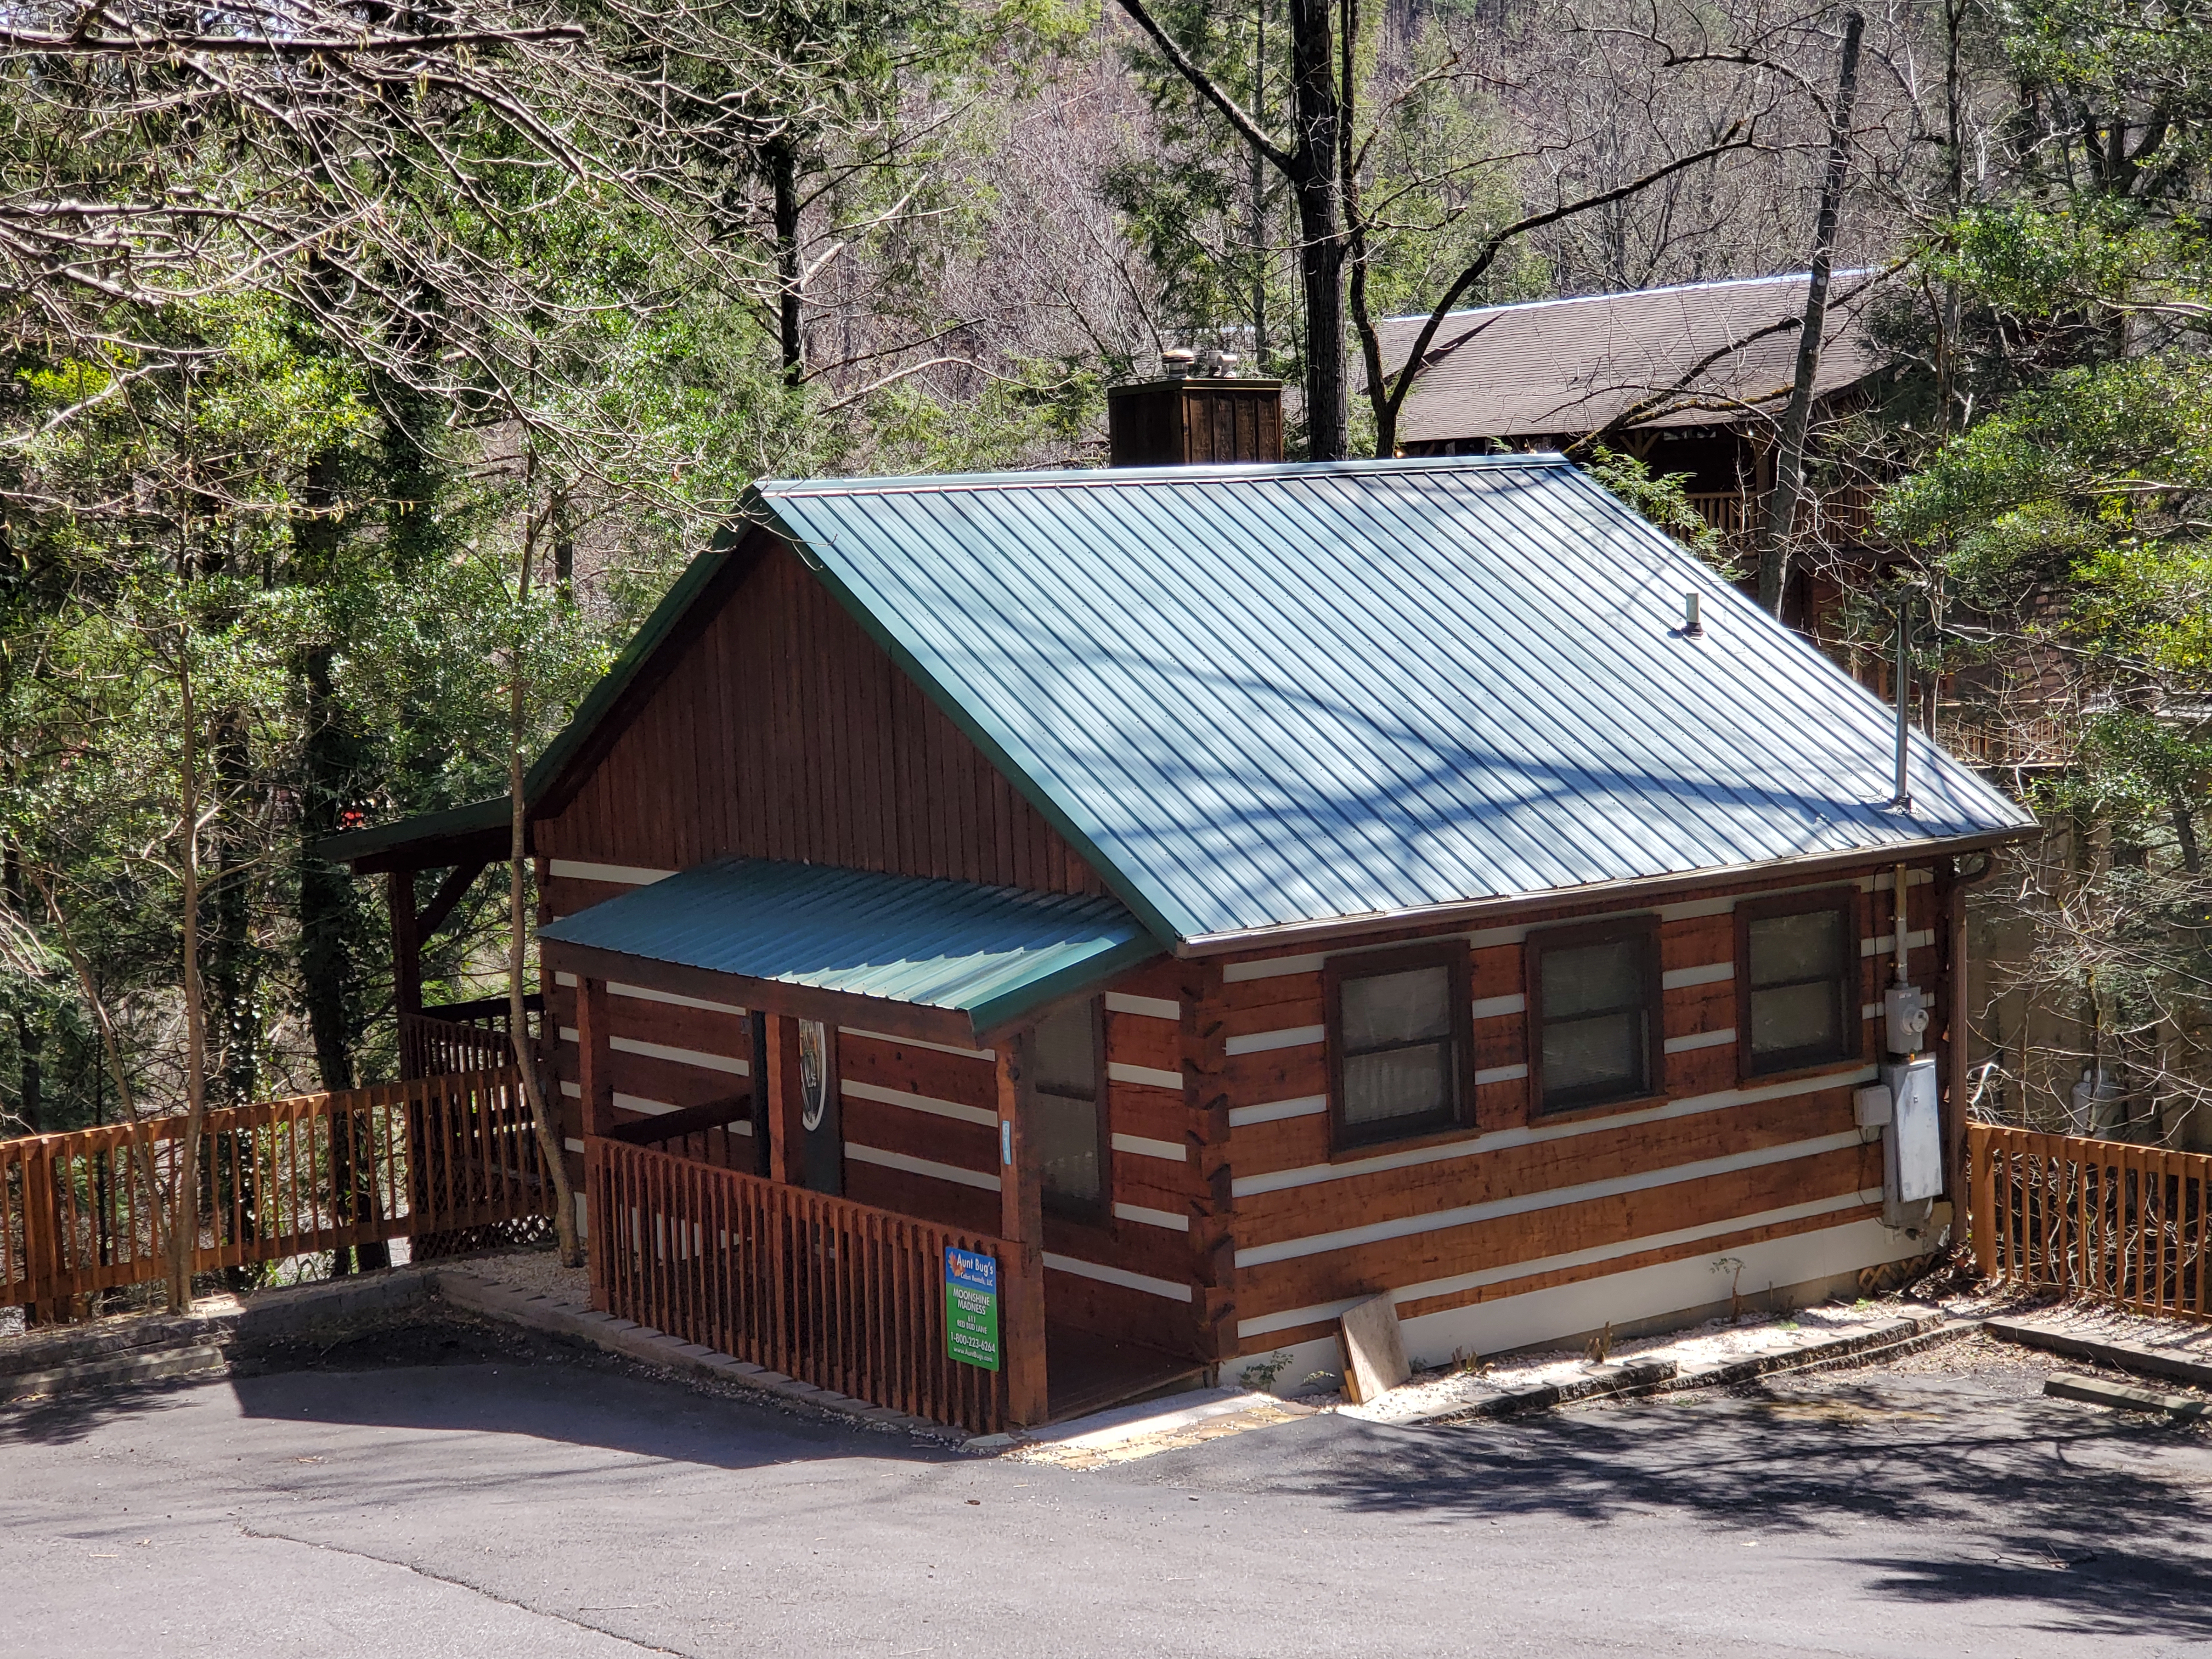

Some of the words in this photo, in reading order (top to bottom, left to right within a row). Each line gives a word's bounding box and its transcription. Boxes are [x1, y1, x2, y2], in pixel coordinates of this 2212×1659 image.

[957, 1253, 973, 1269] Aunt
[975, 1257, 993, 1277] Bug's
[953, 1288, 990, 1306] MOONSHINE
[957, 1299, 986, 1315] MADNESS
[957, 1319, 966, 1328] RED
[966, 1322, 975, 1330] BUD
[975, 1325, 987, 1335] LANE
[950, 1331, 995, 1353] 1-800-223-6264
[953, 1347, 993, 1362] www.AuntBugs.com
